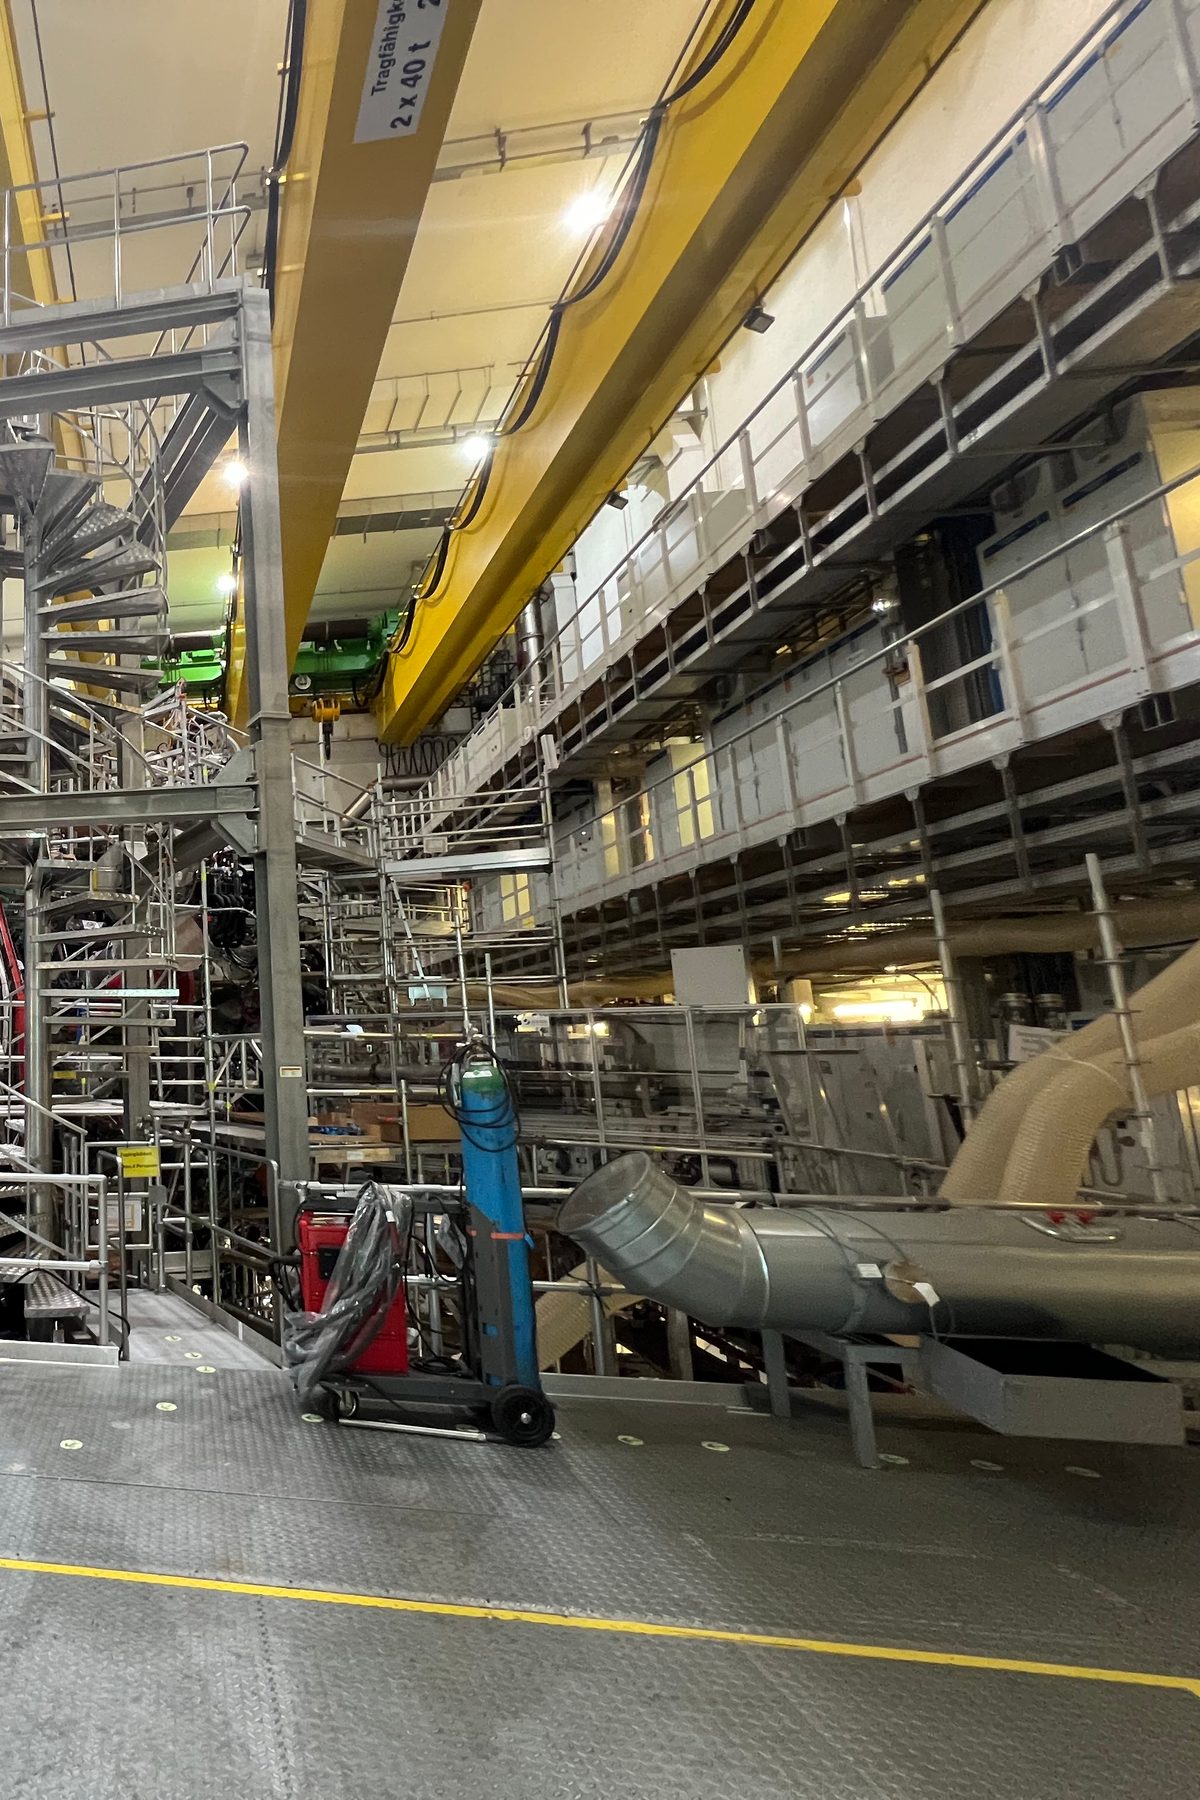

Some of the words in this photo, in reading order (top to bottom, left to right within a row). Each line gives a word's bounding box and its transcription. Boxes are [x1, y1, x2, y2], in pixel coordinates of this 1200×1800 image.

[370, 0, 405, 96] Tragfähigk
[407, 40, 432, 52] t
[400, 59, 426, 88] 40
[398, 94, 418, 110] x
[390, 114, 412, 129] 2
